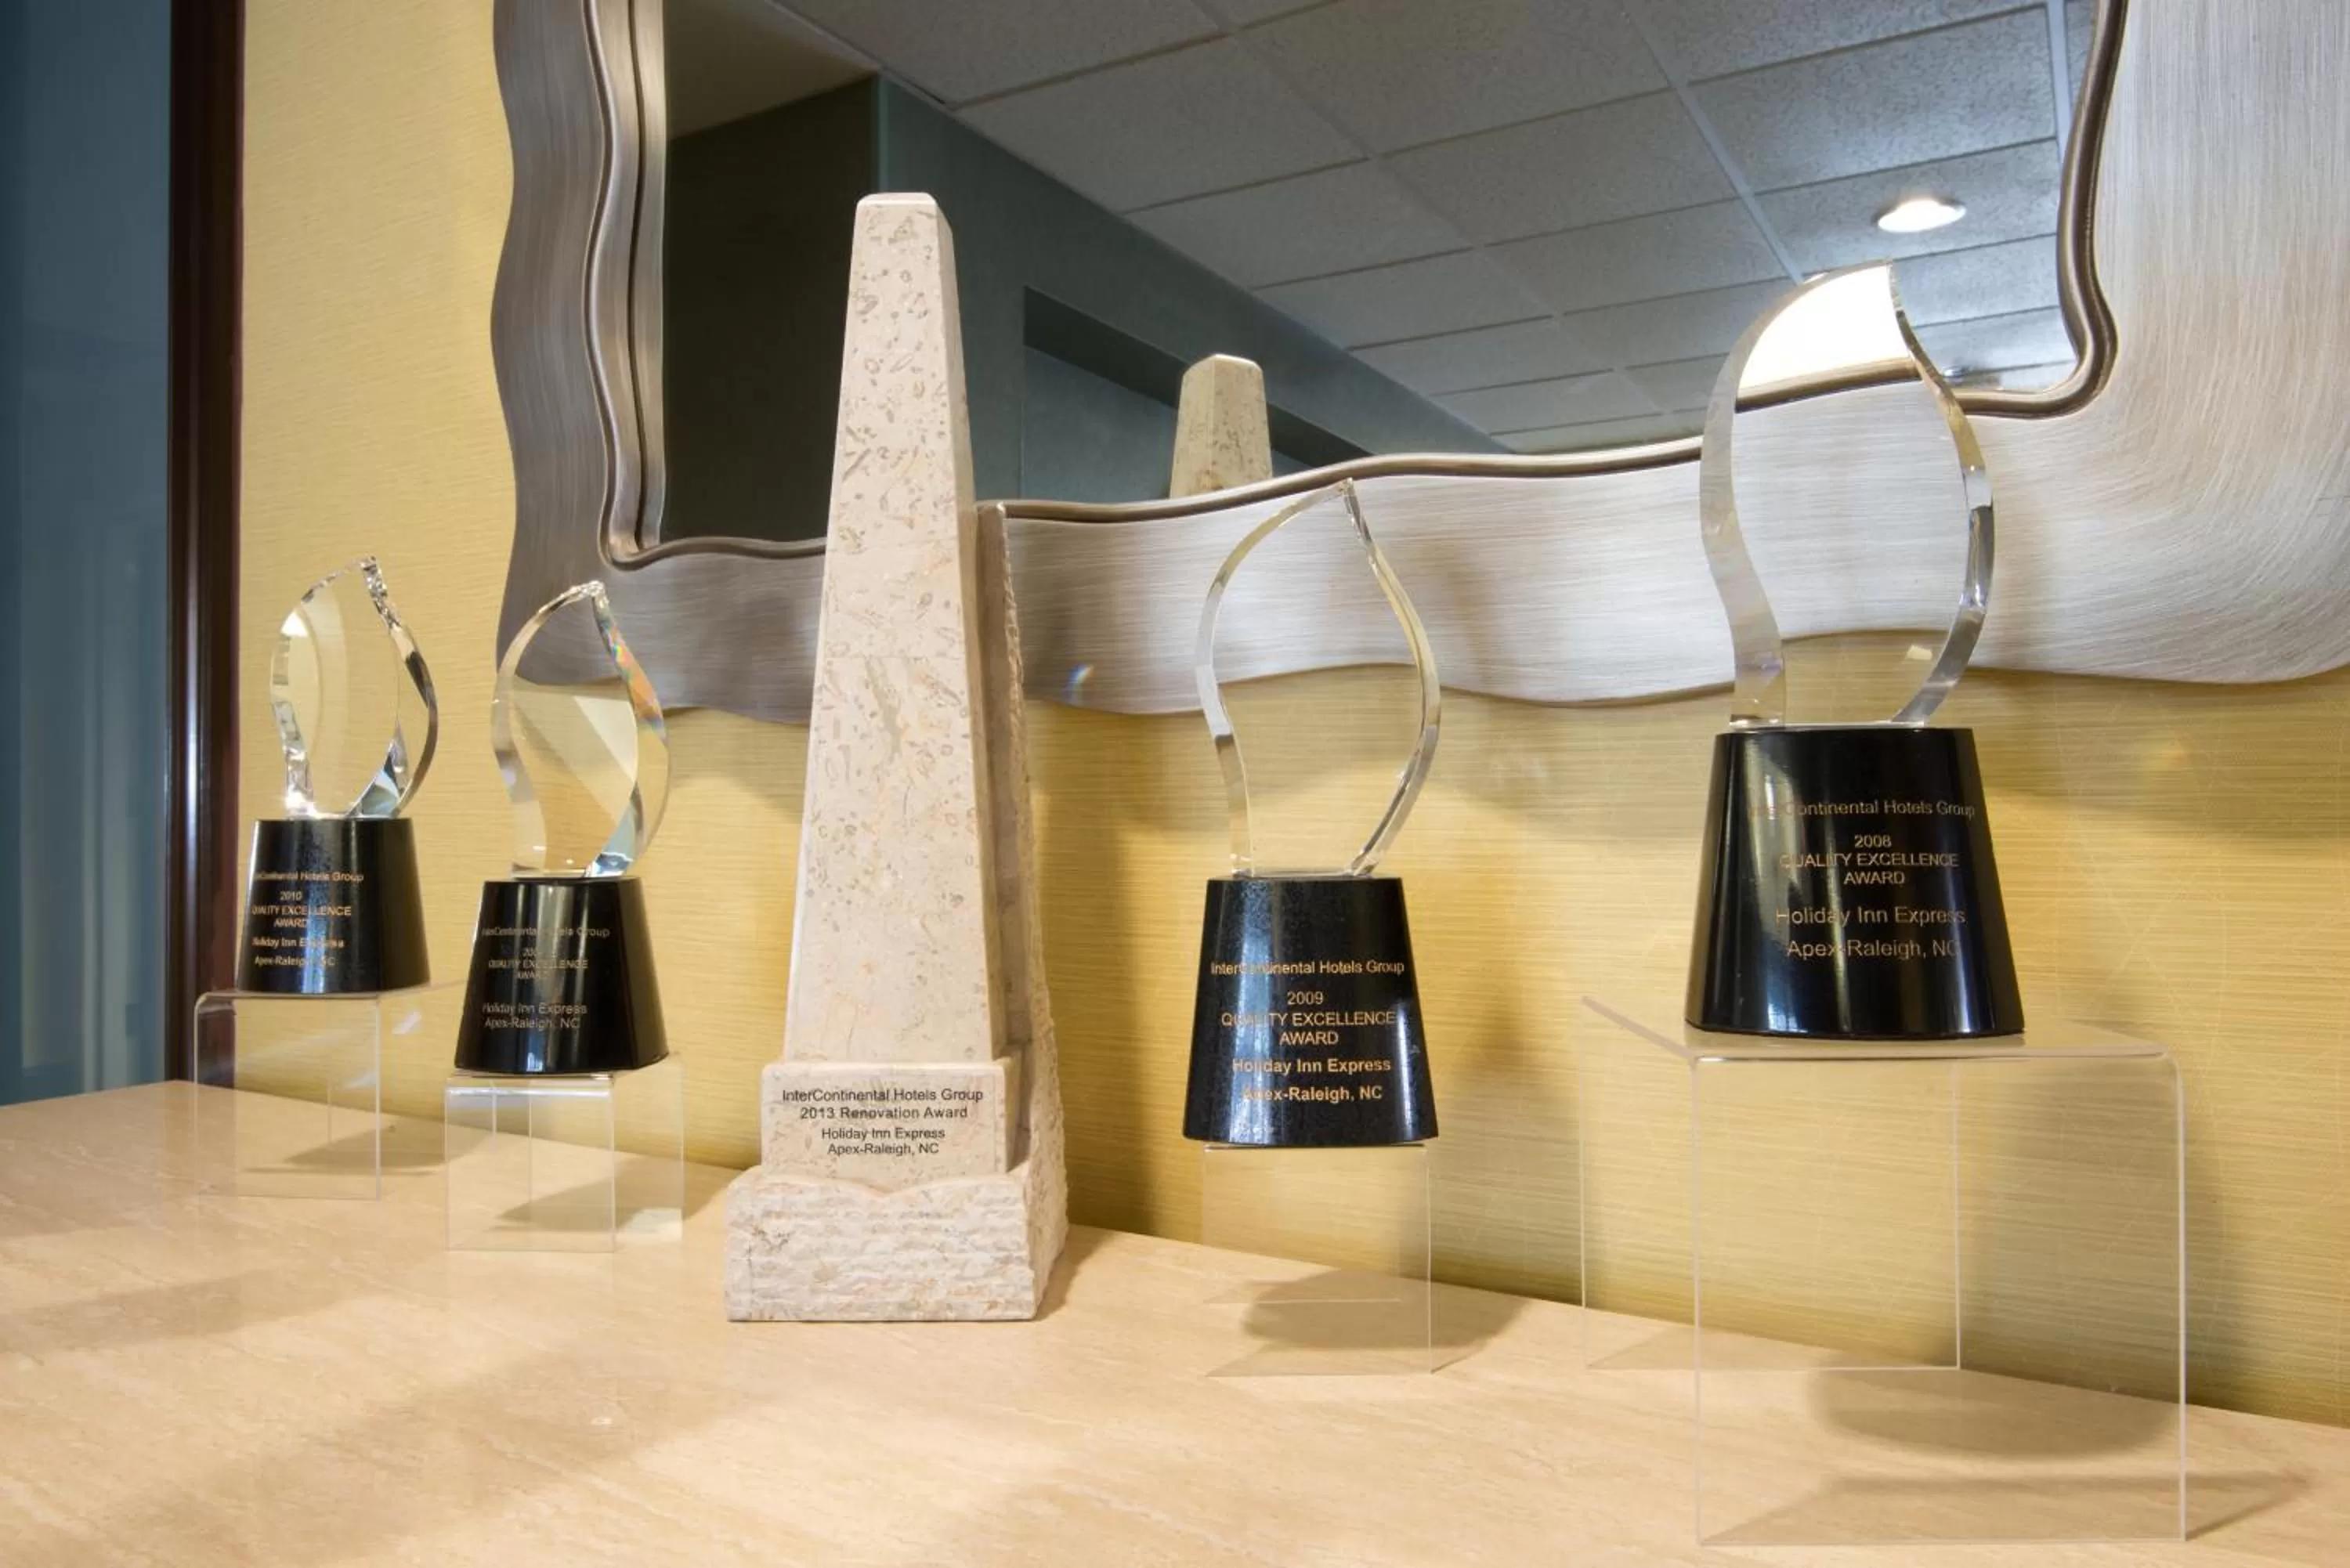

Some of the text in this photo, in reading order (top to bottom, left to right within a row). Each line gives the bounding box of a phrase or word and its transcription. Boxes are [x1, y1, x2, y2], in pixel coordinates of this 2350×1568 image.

[1753, 800, 1975, 818] Continental Hotels Group
[1854, 834, 1892, 849] 2008
[1780, 852, 1958, 868] QUALITY EXCELLENCE
[332, 871, 364, 884] Group
[1843, 871, 1905, 885] AWARD
[251, 905, 352, 916] QUALITY EXCELLENCE
[1776, 905, 1966, 928] Holiday Inn Express
[273, 918, 310, 928] AWARD
[281, 938, 297, 948] Inn
[1932, 939, 1960, 957] NC
[1319, 959, 1363, 974] Hotels
[1366, 959, 1405, 977] Group
[1287, 991, 1324, 1005] 2009
[518, 1003, 535, 1014] Inn
[538, 1003, 588, 1017] Express
[559, 1018, 580, 1029] NC
[1221, 1011, 1396, 1027] QUALITY EXCELLENCE
[1278, 1031, 1339, 1046] AWARD
[1296, 1058, 1323, 1073] Inn
[1328, 1058, 1392, 1076] Express
[783, 1088, 984, 1104] InterContinental Hotels Group
[1359, 1085, 1383, 1100] NC
[800, 1106, 968, 1120] 2013 Renovation Award
[822, 1127, 946, 1142] Holiday Inn Express
[827, 1143, 940, 1158] Apex-Raleigh, NC
